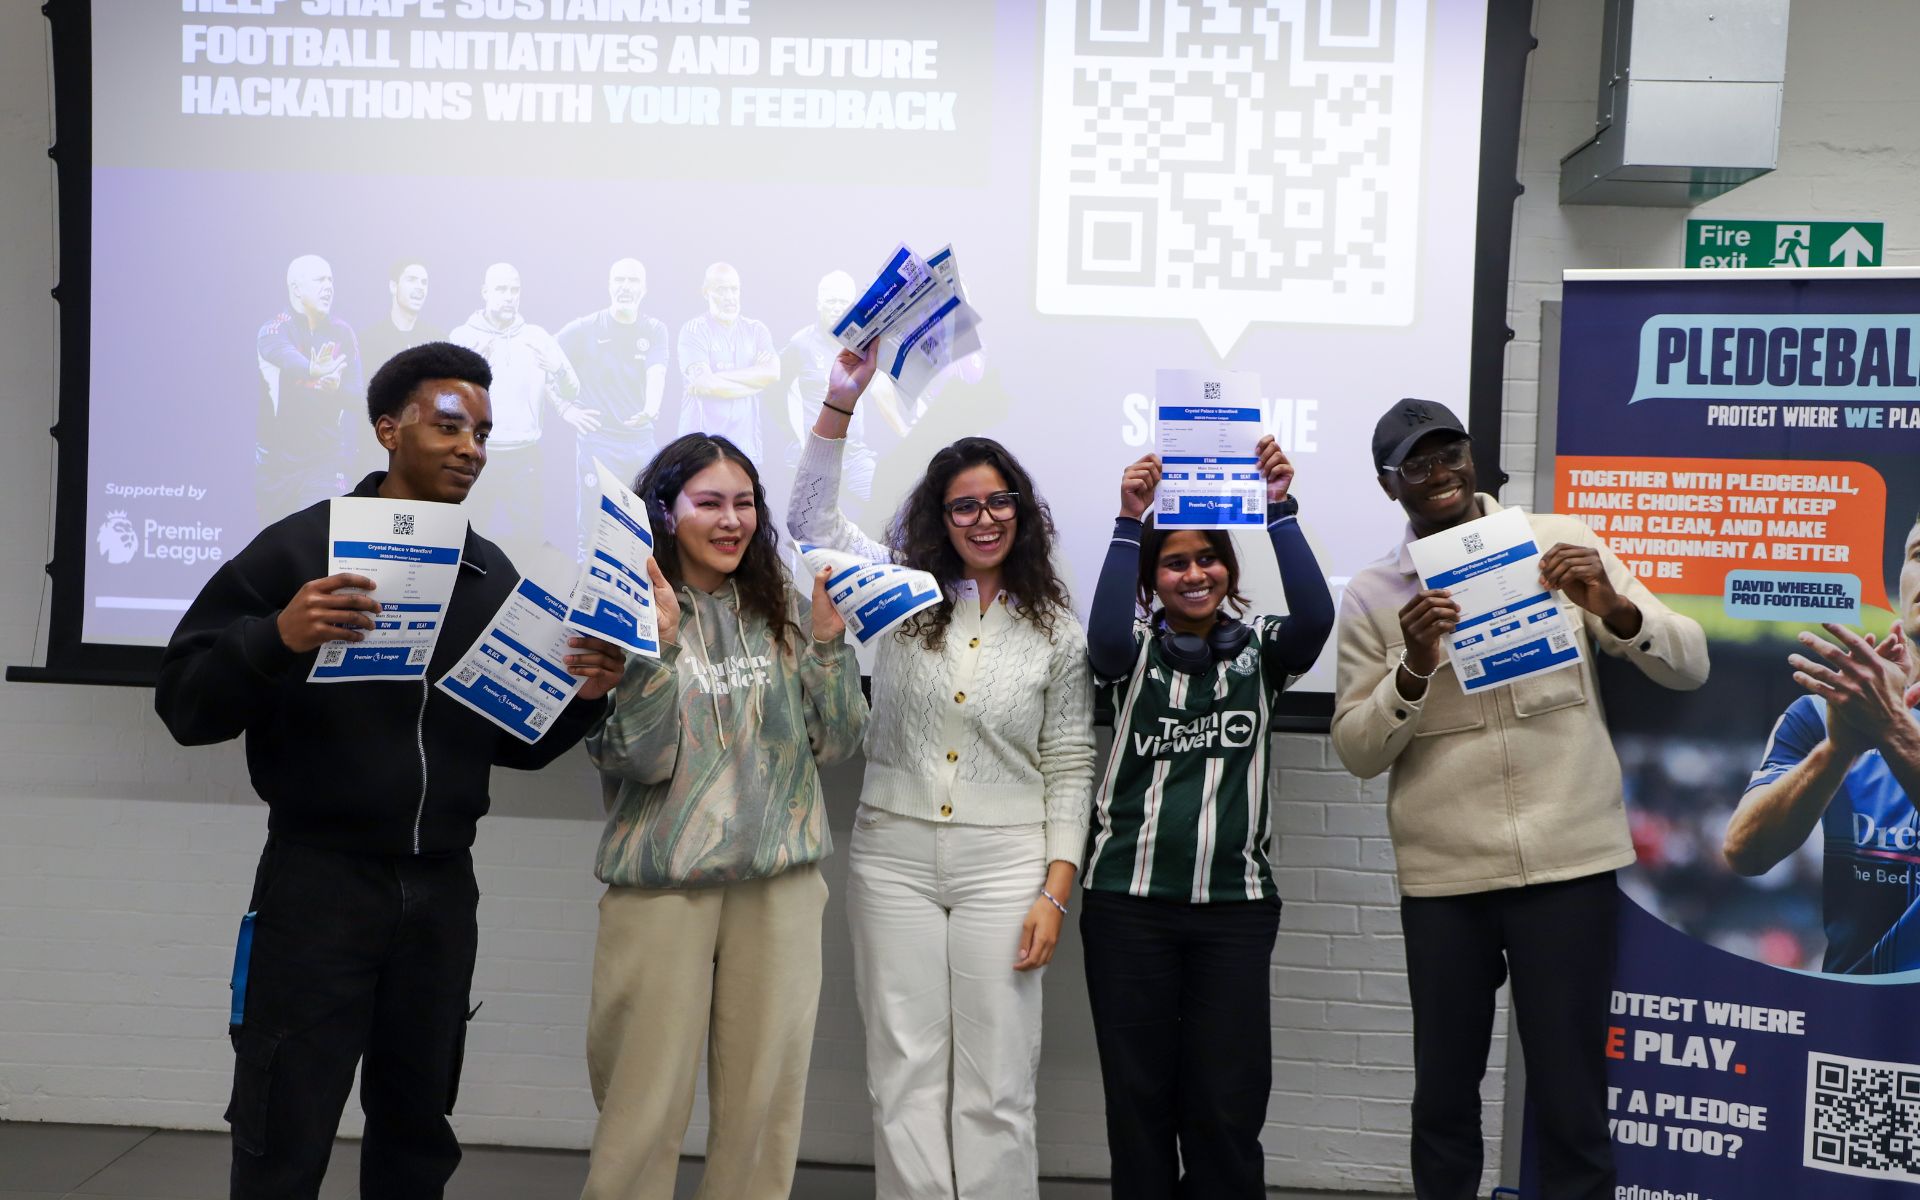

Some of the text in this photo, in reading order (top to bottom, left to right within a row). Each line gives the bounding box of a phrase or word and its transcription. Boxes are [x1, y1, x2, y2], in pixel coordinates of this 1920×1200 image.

[182, 24, 939, 79] FOOTBALL INITIATIVES AND FUTURE
[181, 76, 958, 131] HACKATHONS WITH YOUR FEEDBACK
[1699, 225, 1751, 246] Fire
[1700, 251, 1748, 268] exit
[1656, 326, 1920, 387] PLEDGEBAL
[1707, 404, 1920, 429] PROTECT WHERE WE PLA
[104, 482, 207, 501] Supported by
[1568, 470, 1859, 496] TOGETHER WITH PLEDGEBALL,
[1567, 492, 1837, 517] I MAKE CHOICES THAT KEEP
[144, 519, 222, 542] Premier
[1610, 515, 1644, 533] AIR
[1647, 516, 1716, 537] CLEAN,
[1720, 519, 1764, 537] AND
[1767, 520, 1827, 539] MAKE
[144, 539, 222, 564] League
[1611, 537, 1749, 559] ENVIRONMENT
[1752, 540, 1768, 559] A
[1772, 542, 1851, 563] BETTER
[1628, 559, 1684, 579] TO BE
[1732, 579, 1847, 598] DAVID WHEELER,
[1730, 593, 1856, 611] PRO FOOTBALLER
[380, 654, 400, 662] League
[482, 684, 499, 698] Premier
[505, 697, 522, 713] League
[1157, 711, 1219, 741] Team
[1133, 730, 1219, 757] Viewer
[1852, 812, 1920, 850] Dre
[1877, 869, 1910, 884] Bed
[1609, 990, 1806, 1036] OTECT WHERE
[1605, 1025, 1747, 1076] E PLAY.
[1627, 1089, 1649, 1115] A
[1654, 1092, 1768, 1132] PLEDGE
[1663, 1126, 1743, 1160] TOO?
